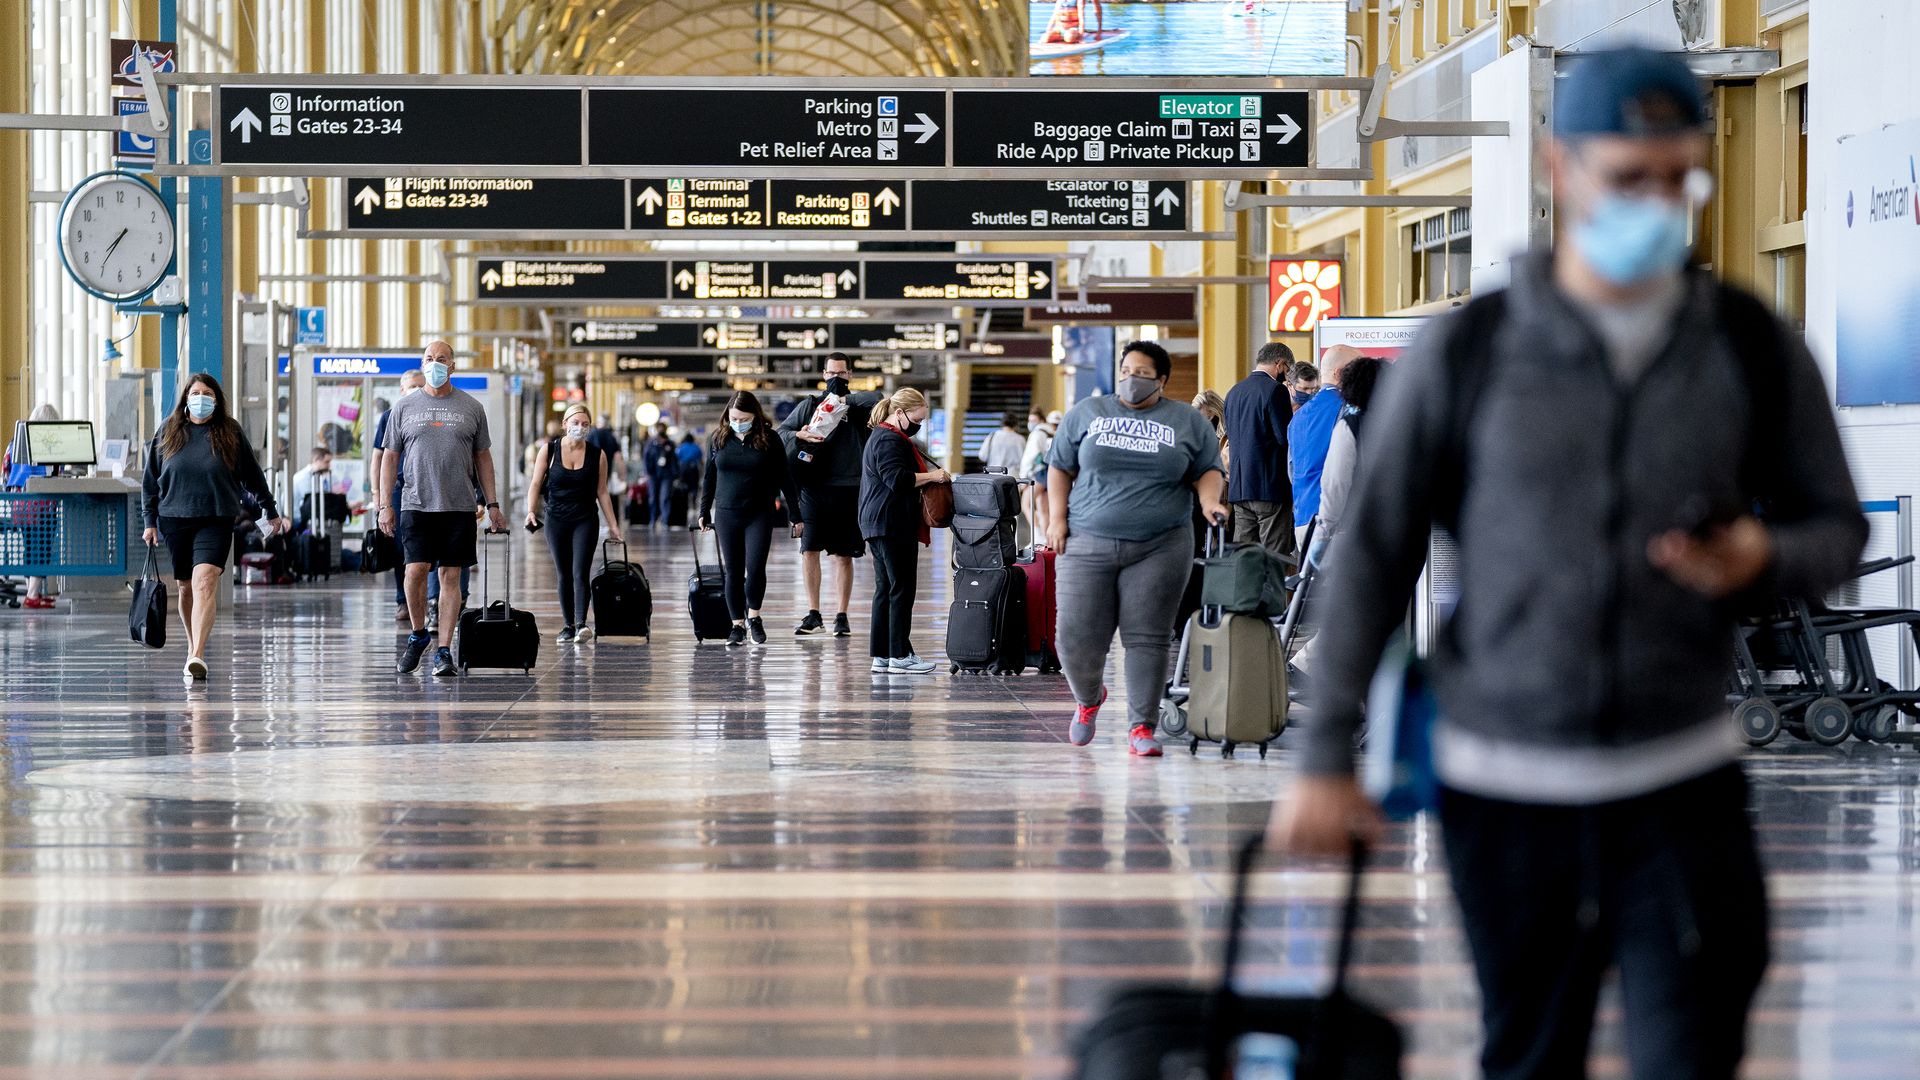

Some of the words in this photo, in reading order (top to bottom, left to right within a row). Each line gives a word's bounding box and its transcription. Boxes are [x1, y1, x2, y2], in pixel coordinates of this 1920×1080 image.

[297, 95, 404, 112] Information
[805, 98, 872, 118] Parking
[882, 99, 894, 114] C
[1161, 99, 1235, 115] Elevator
[297, 118, 348, 134] Gates
[353, 118, 402, 134] 23-34
[817, 120, 872, 136] Metro
[1034, 121, 1112, 141] Baggage
[1117, 121, 1166, 137] Claim
[1198, 121, 1235, 137] Taxi
[740, 142, 768, 158] Pet
[774, 141, 825, 158] Relief
[829, 142, 872, 158] Area
[997, 143, 1036, 159] Ride
[1041, 143, 1078, 162] App
[1110, 143, 1171, 159] Private
[1176, 143, 1234, 162] Pickup
[405, 178, 447, 192] Flight
[449, 178, 533, 191] Information
[689, 179, 749, 191] Terminal
[1046, 180, 1109, 191] Escalator
[1112, 180, 1128, 191] To
[97, 196, 104, 208] 11
[116, 191, 124, 203] 12
[405, 194, 447, 208] Gates
[449, 194, 488, 208] 23-34
[689, 194, 749, 208] Terminal
[796, 194, 849, 211] Parking
[1065, 194, 1129, 211] Ticketing
[1869, 179, 1908, 224] American
[84, 210, 91, 222] 10
[151, 211, 155, 223] 2
[688, 211, 728, 225] Gates
[731, 211, 762, 225] 1-22
[777, 211, 850, 226] Restrooms
[971, 211, 1028, 225] Shuttles
[1051, 211, 1095, 225] Rental
[1099, 211, 1128, 225] Cars
[78, 230, 82, 242] 9
[158, 232, 162, 244] 3
[84, 251, 89, 264] 8
[150, 252, 155, 263] 4
[101, 265, 105, 277] 7
[137, 266, 141, 278] 5
[516, 262, 545, 275] Flight
[117, 269, 122, 283] 6
[1345, 331, 1380, 339] PROJECT
[320, 359, 380, 373] NATURAL
[436, 412, 464, 423] BEACH
[1096, 432, 1160, 453] ALUMNI
